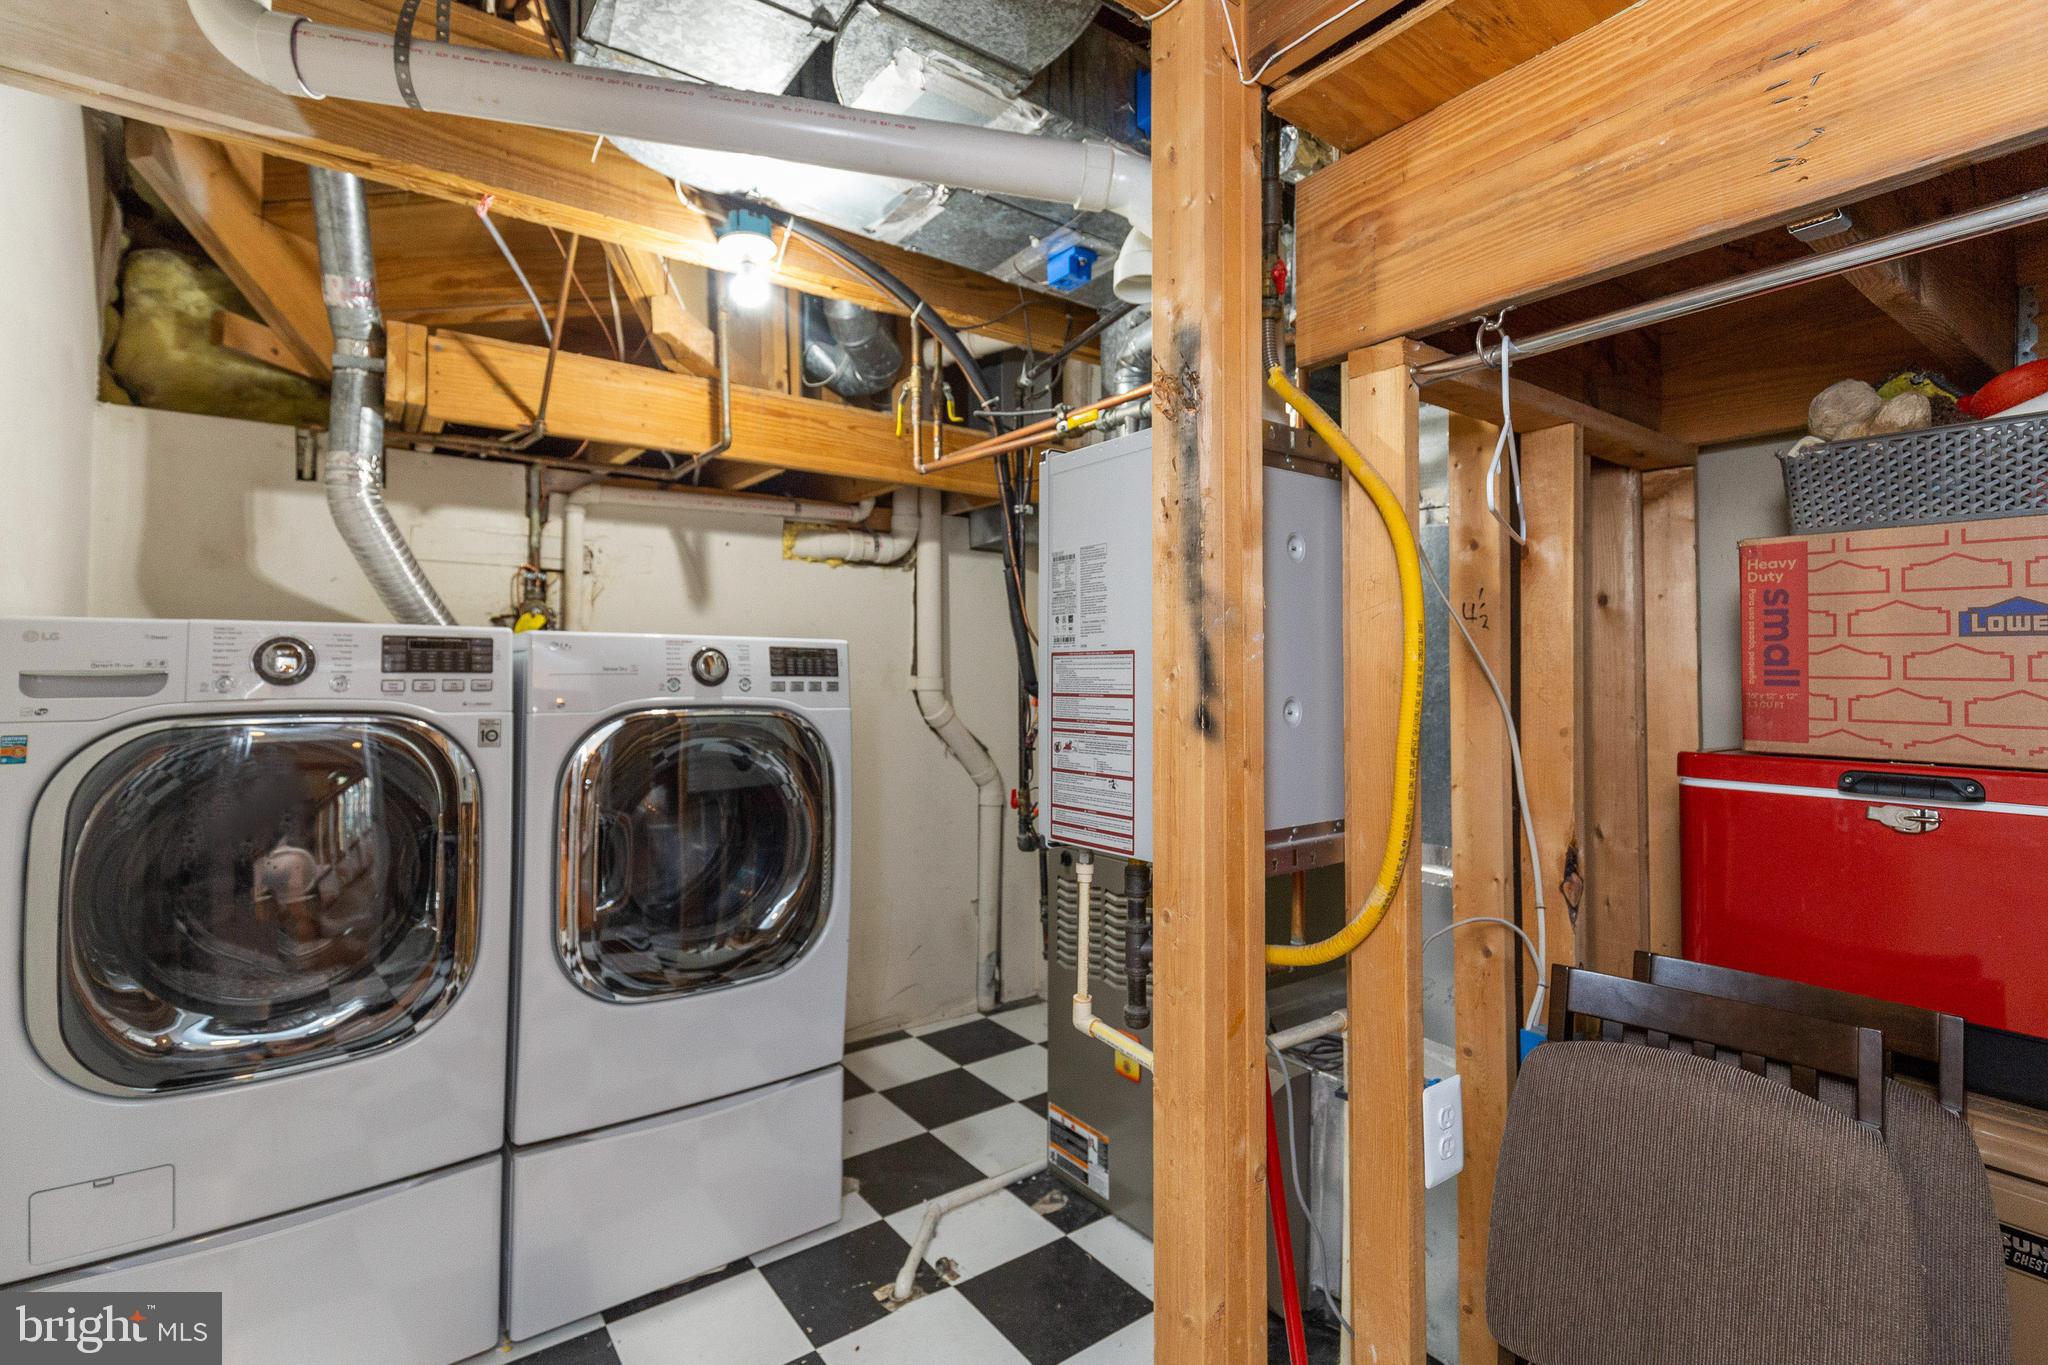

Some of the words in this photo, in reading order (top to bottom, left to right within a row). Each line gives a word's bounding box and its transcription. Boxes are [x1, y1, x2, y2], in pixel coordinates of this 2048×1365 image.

[1747, 559, 1797, 571] Heavy
[1747, 571, 1784, 584] Duty
[41, 632, 60, 641] LG
[1763, 588, 1800, 687] small
[2013, 1251, 2048, 1274] CHEST
